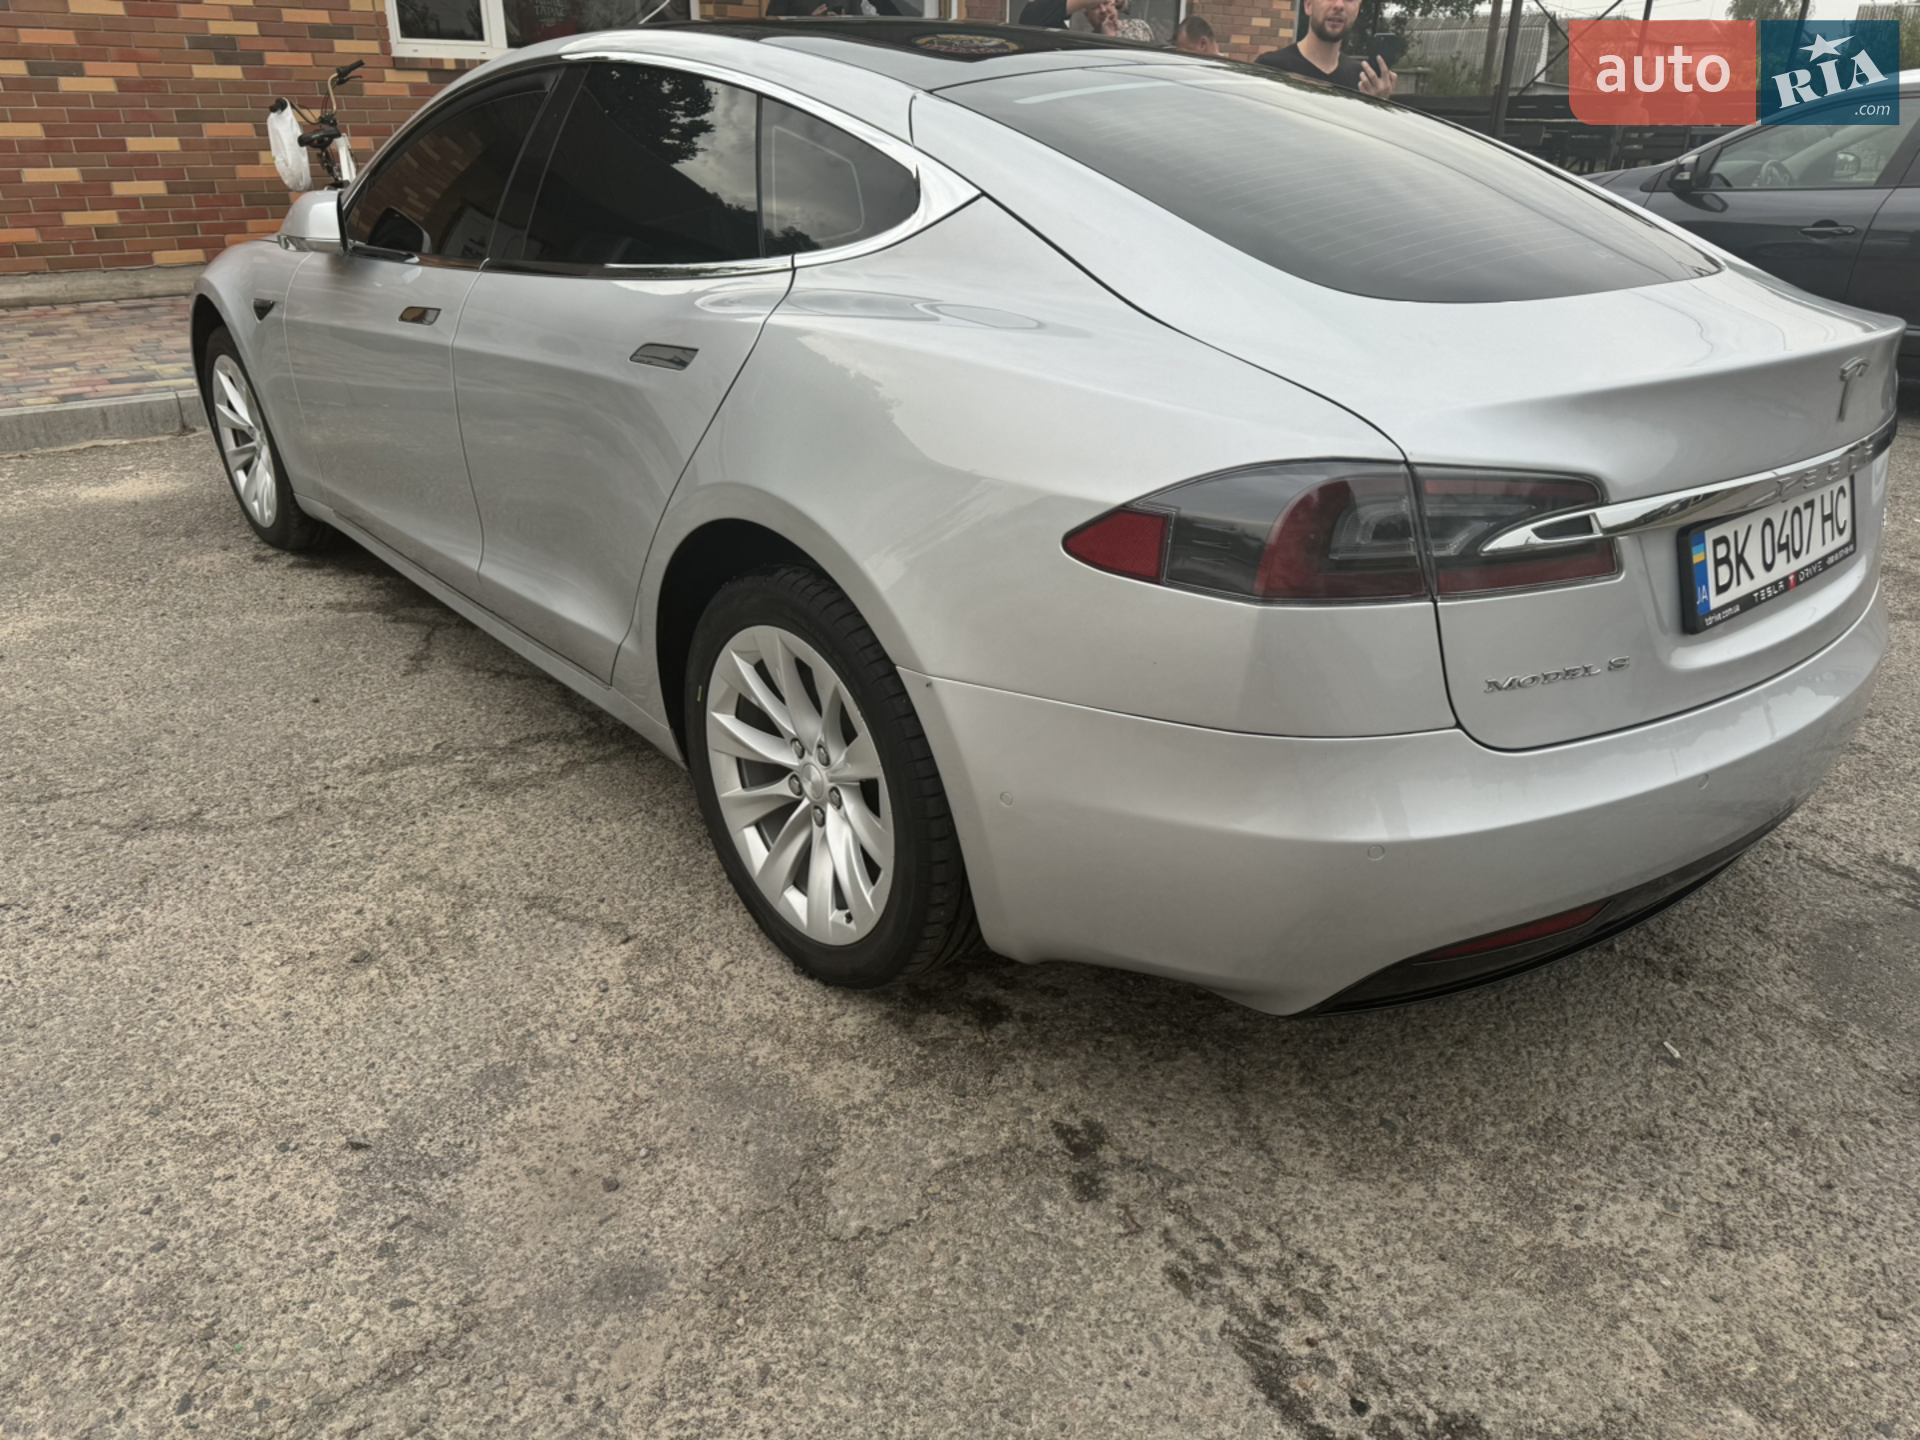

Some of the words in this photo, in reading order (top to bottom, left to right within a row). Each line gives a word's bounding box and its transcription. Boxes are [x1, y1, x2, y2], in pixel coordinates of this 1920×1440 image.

[1711, 523, 1755, 597] BK
[1760, 498, 1816, 573] 0407
[1820, 485, 1848, 547] HC
[1752, 580, 1785, 603] TESLA
[1798, 560, 1824, 582] DRIVE
[1483, 663, 1602, 694] MODEL
[1607, 655, 1631, 672] S
